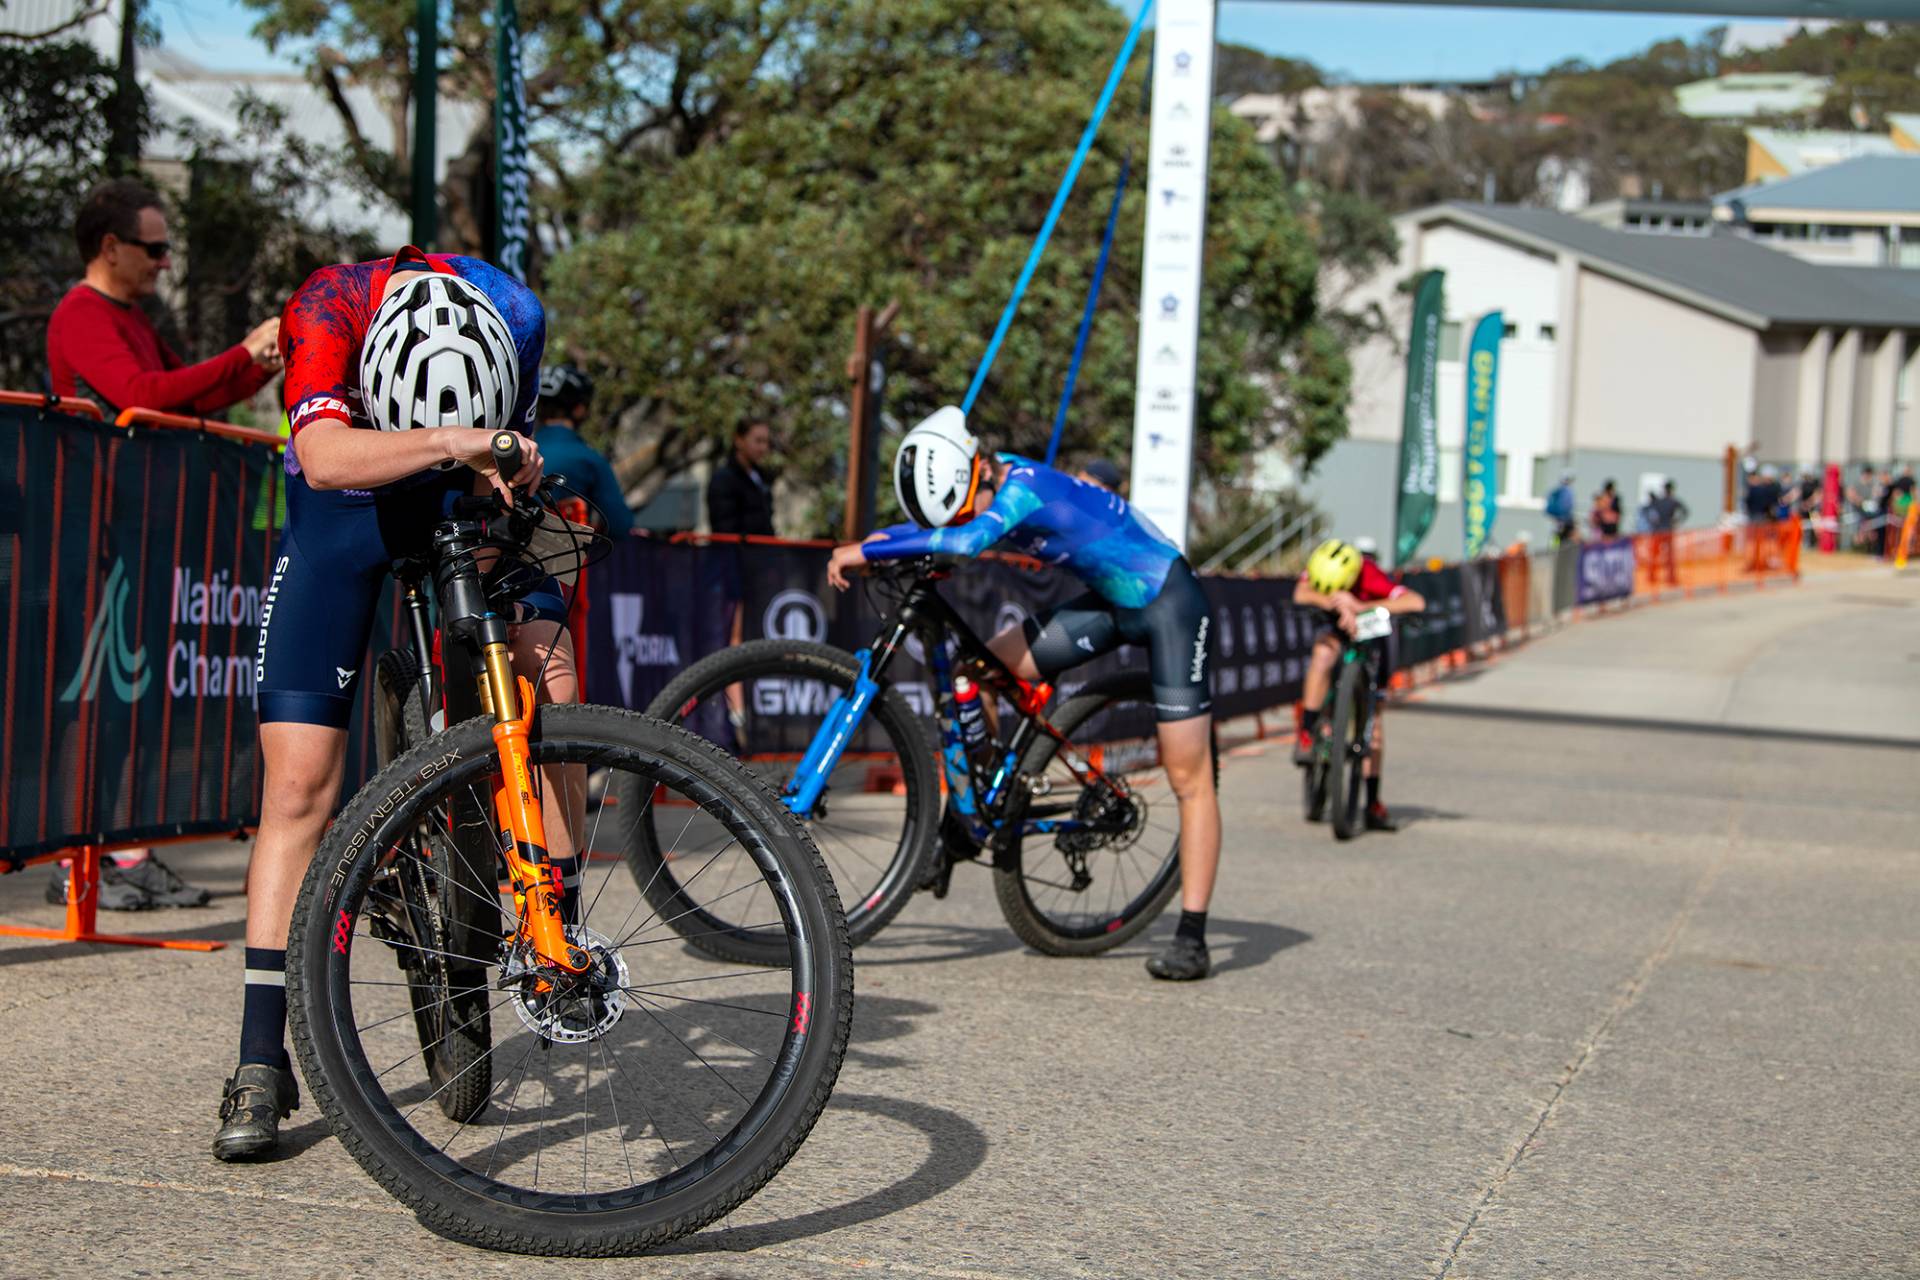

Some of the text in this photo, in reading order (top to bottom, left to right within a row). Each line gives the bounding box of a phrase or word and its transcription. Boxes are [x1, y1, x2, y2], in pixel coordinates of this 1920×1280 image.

[256, 555, 290, 683] SHIMANO
[330, 747, 463, 888] XR3 TEAM ISSUE
